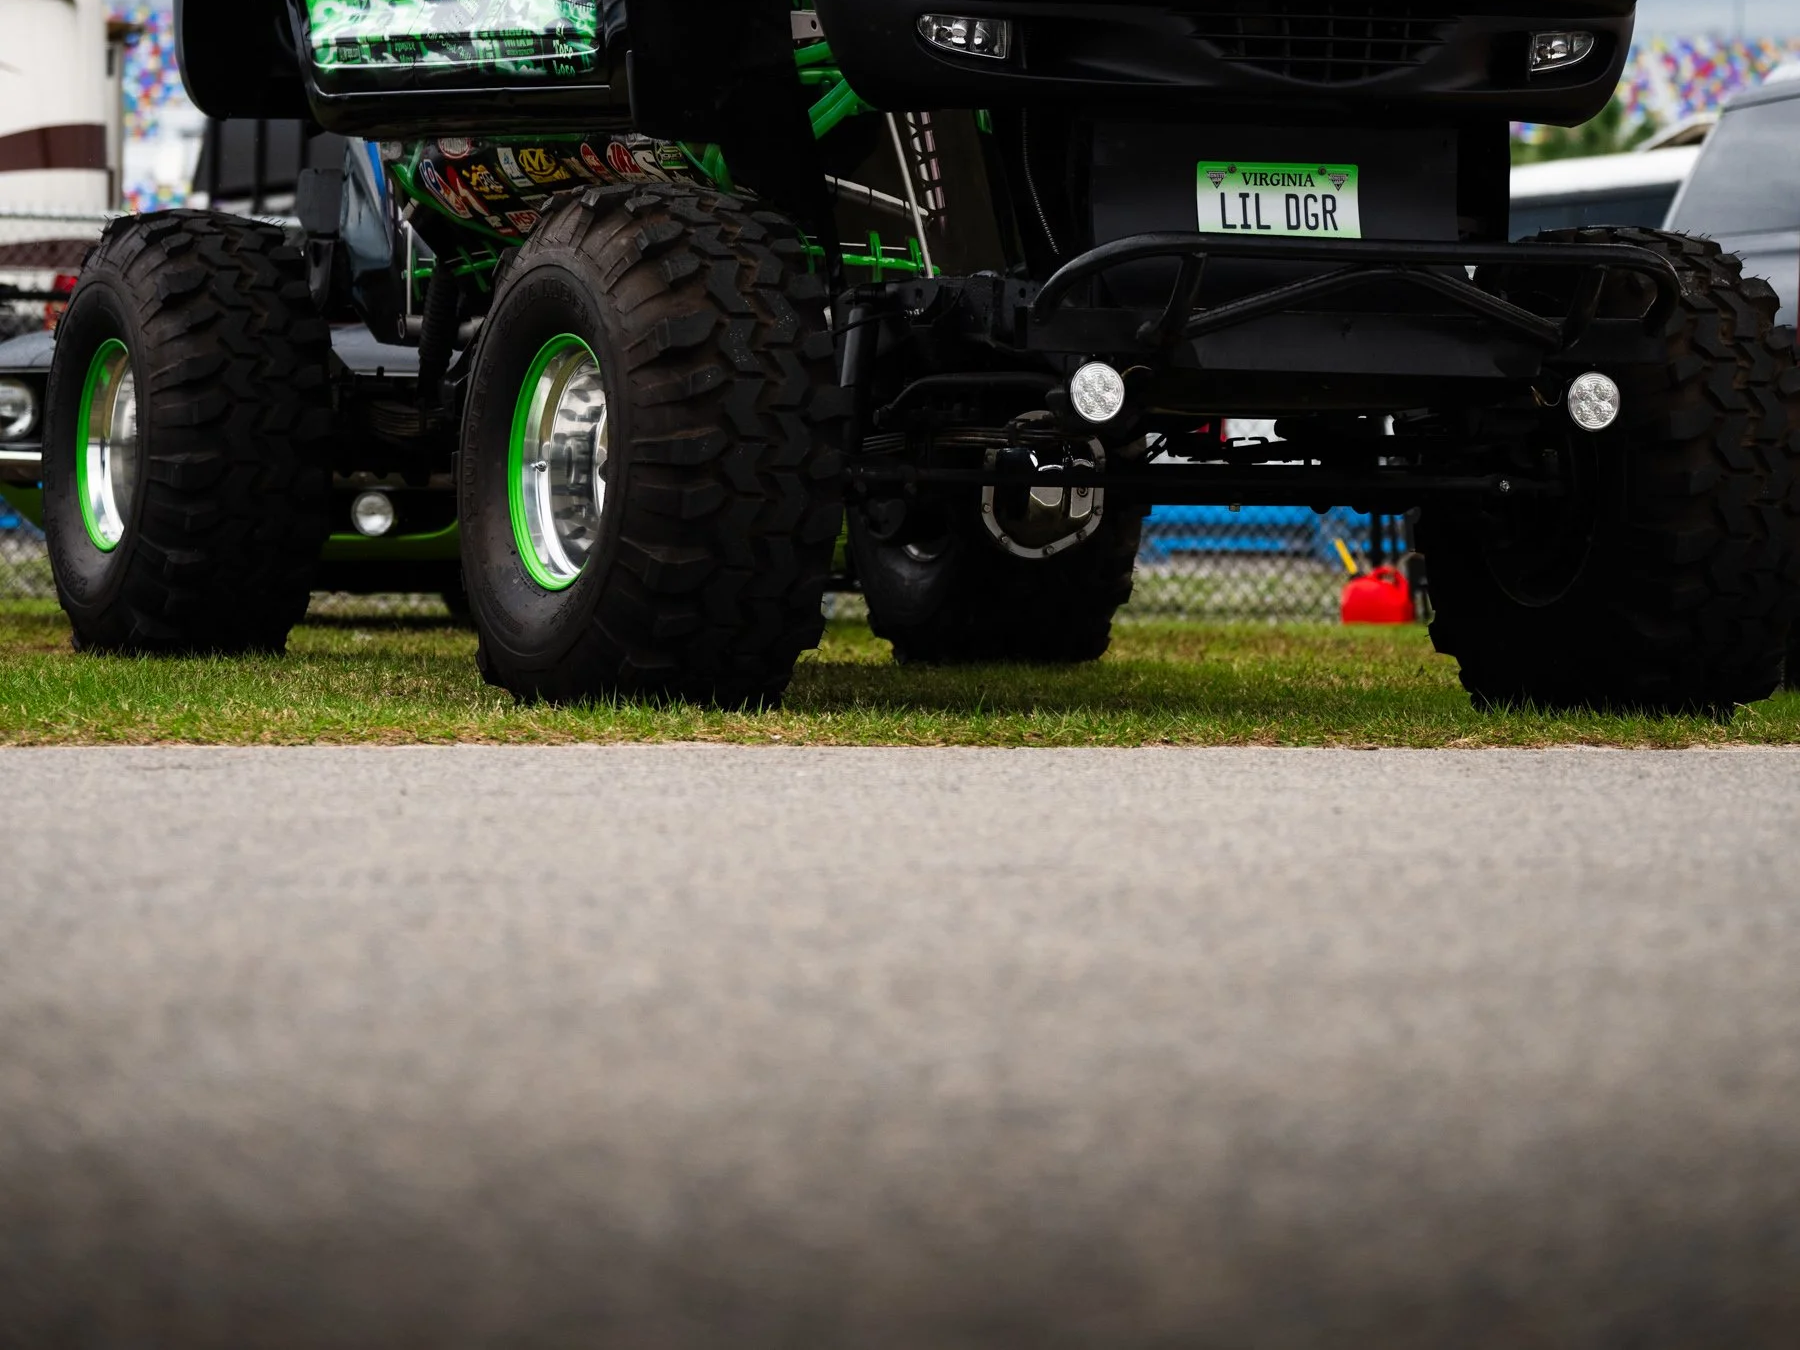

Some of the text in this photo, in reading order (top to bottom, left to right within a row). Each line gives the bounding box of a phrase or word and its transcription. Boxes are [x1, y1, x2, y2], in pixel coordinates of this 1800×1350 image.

[1241, 171, 1315, 188] VIRGINIA
[1220, 192, 1338, 231] LIL DGR
